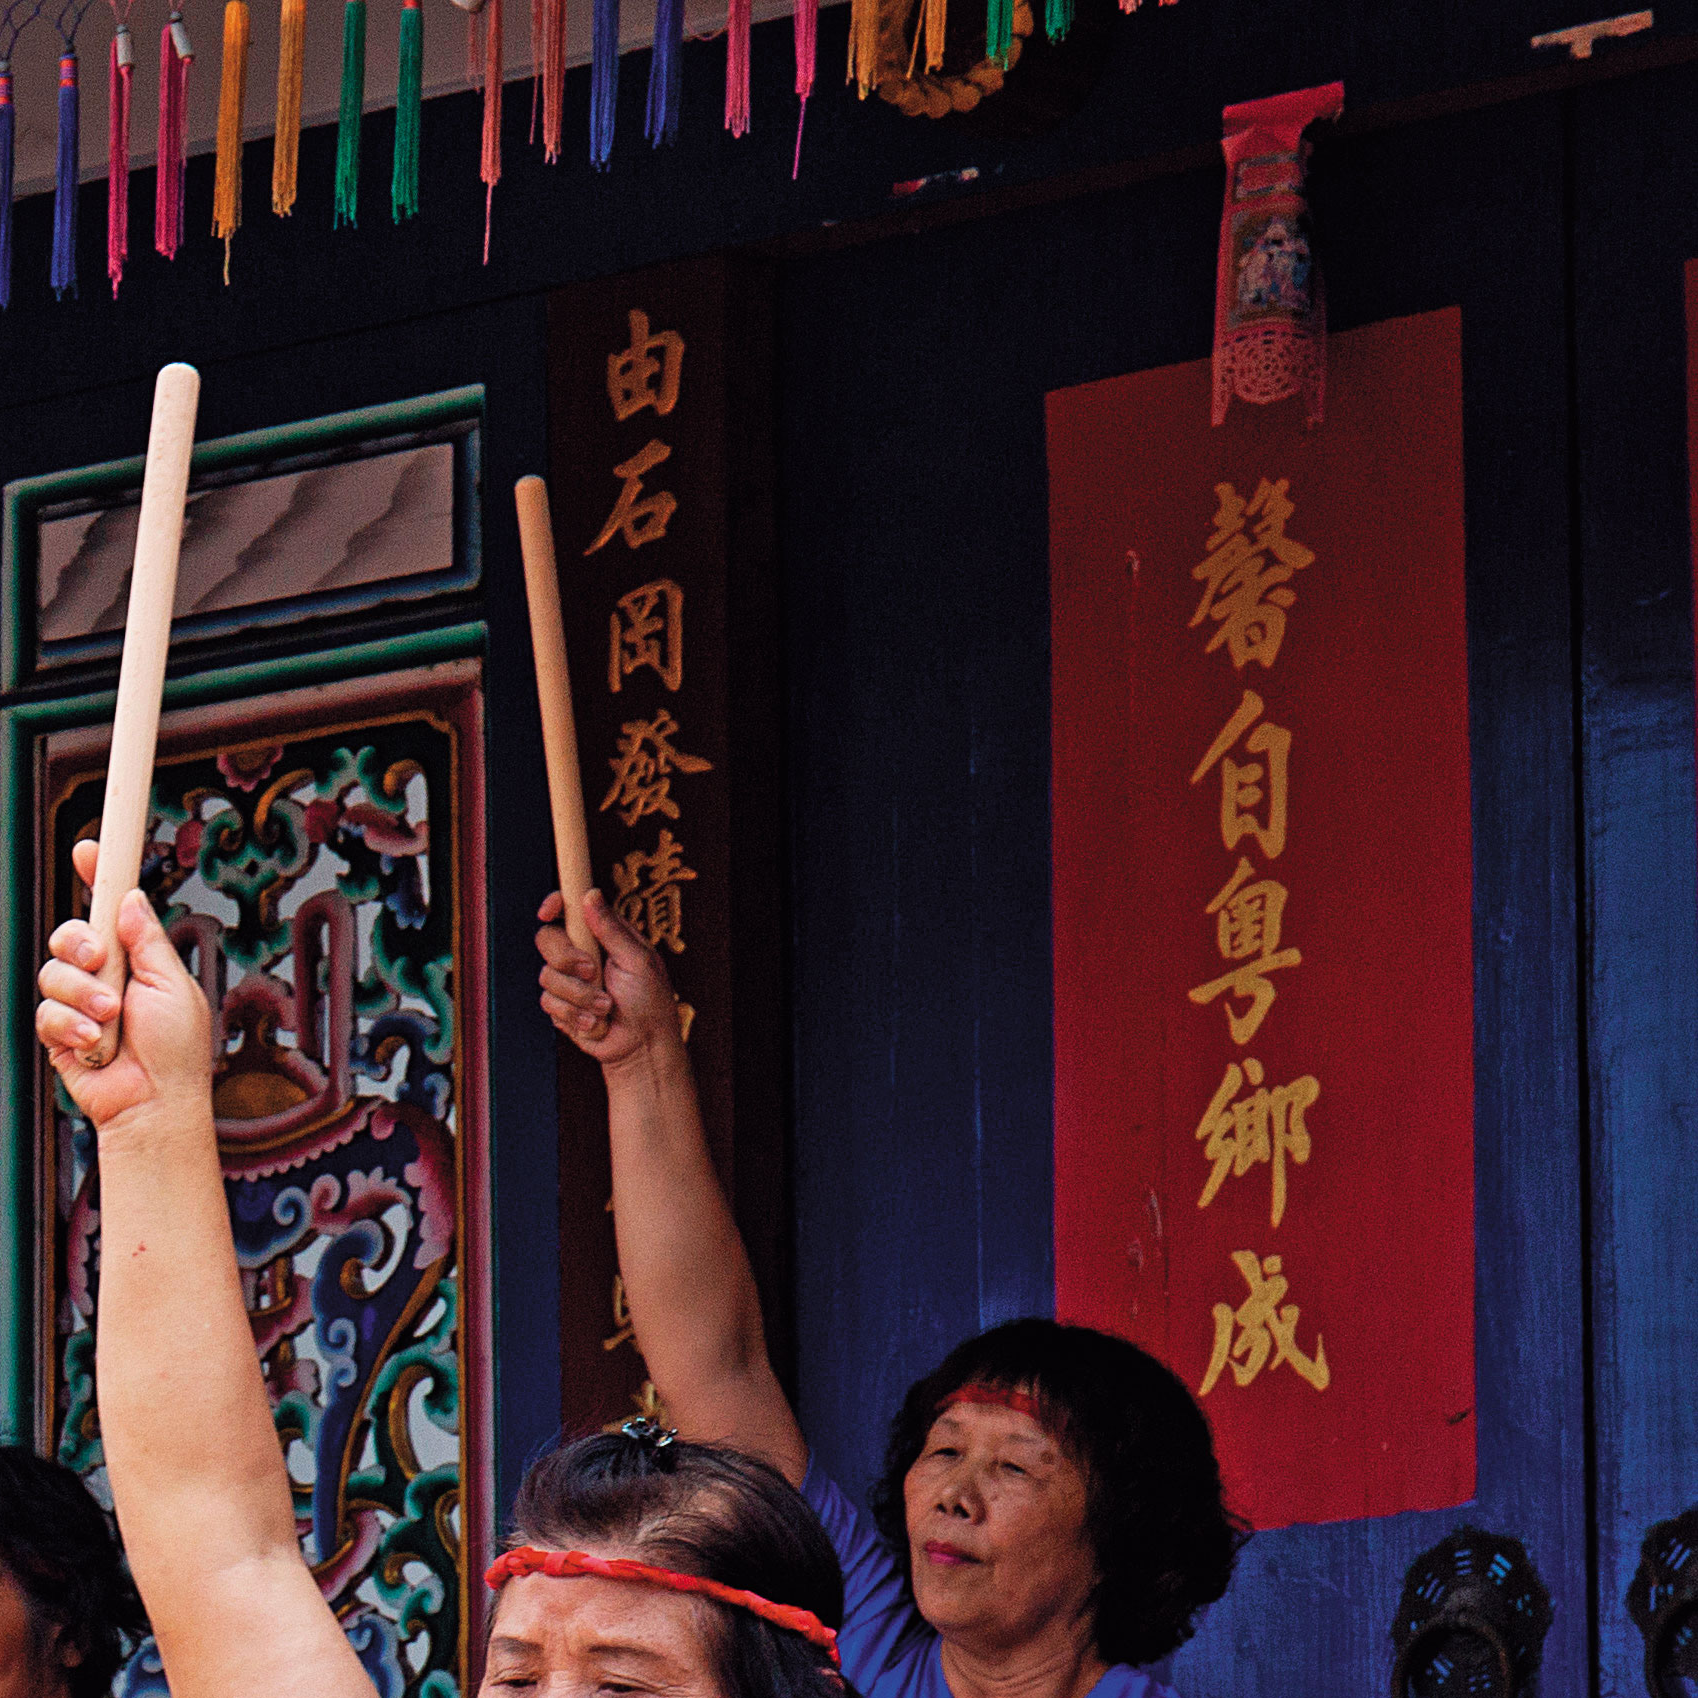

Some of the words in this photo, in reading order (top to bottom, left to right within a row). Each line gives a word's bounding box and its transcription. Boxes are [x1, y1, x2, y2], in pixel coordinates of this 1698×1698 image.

[584, 311, 712, 1432] 由石岡發蹟
